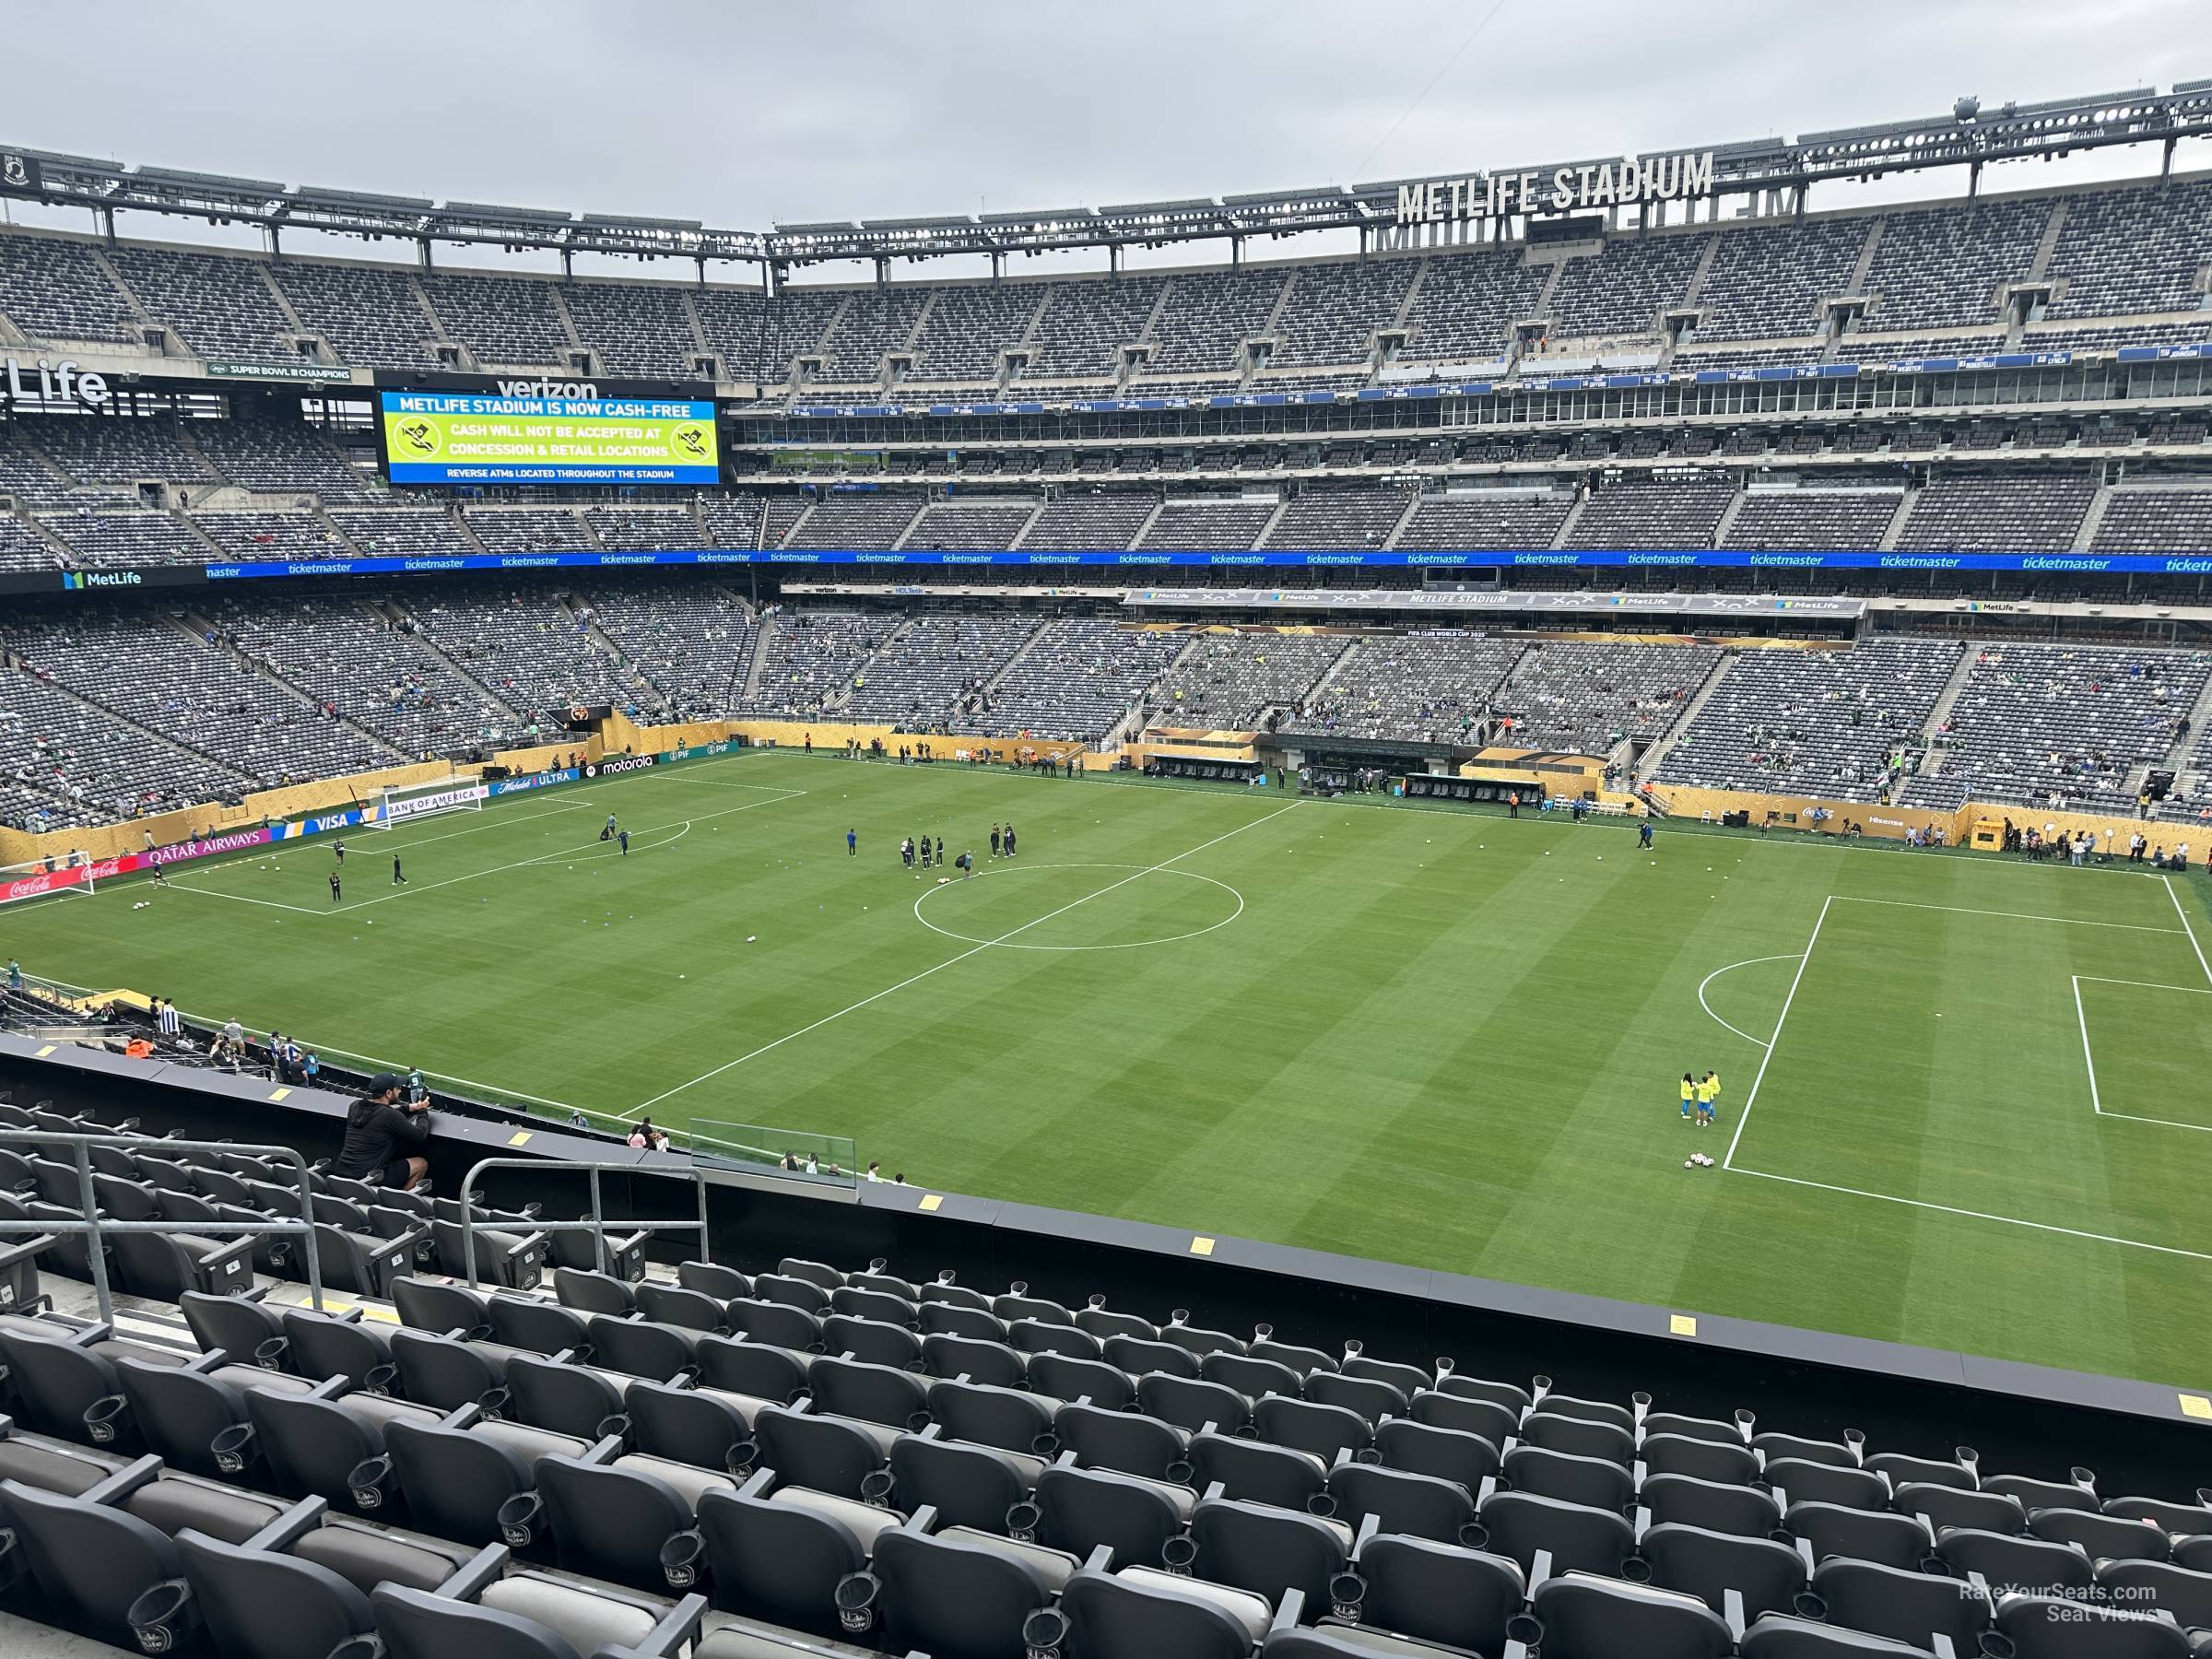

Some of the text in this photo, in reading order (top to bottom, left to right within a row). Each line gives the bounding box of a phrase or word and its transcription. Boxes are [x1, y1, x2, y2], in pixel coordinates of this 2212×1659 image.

[1397, 171, 1539, 224] METLIFE
[1552, 151, 1714, 210] STADIUM
[230, 365, 260, 374] SUPER
[262, 367, 289, 376] BOWL
[300, 369, 350, 379] CHAMPIONS
[0, 358, 108, 403] Life
[497, 377, 598, 400] verizon
[400, 397, 691, 418] METLIFE STADIUM IS NOW CASH-FREE
[451, 424, 662, 440] CASH WILL NOT BE ACCEPTED AT
[449, 443, 668, 457] CONCESSION & RETAIL LOCATIONS
[447, 468, 674, 478] REVERSE ATMs LOCATED THROUGHOUT THE STADIUM
[501, 557, 559, 566] ticketmaster
[601, 554, 656, 563] ticketmaster
[698, 553, 750, 561] ticketmaster
[771, 553, 819, 561] ticketmaster
[856, 553, 906, 562] ticketmaster
[943, 554, 993, 562] ticketmaster
[1030, 554, 1080, 562] ticketmaster
[1120, 554, 1171, 563] ticketmaster
[1211, 554, 1265, 563] ticketmaster
[1307, 554, 1364, 563] ticketmaster
[1407, 553, 1467, 563] ticketmaster
[1514, 553, 1579, 563] ticketmaster
[1628, 553, 1697, 564] ticketmaster
[1750, 554, 1823, 565] ticketmaster
[1881, 555, 1960, 567] ticketmaster
[288, 563, 351, 573] ticketmaster
[406, 559, 465, 570] ticketmaster
[2022, 556, 2111, 570] ticketmaster
[87, 571, 142, 586] MetLife
[1409, 594, 1509, 604] METLIFE STADIUM
[677, 749, 689, 759] PIF
[715, 744, 728, 753] PIF
[603, 756, 653, 775] motorola
[539, 772, 571, 786] ULTRA
[387, 802, 416, 815] BANK
[417, 799, 429, 808] OF
[314, 815, 348, 830] VISA
[1868, 817, 1904, 827] Hisense
[149, 831, 260, 863] QATAR AIRWAYS
[81, 860, 119, 881] Coca-Cola
[10, 877, 51, 898] Coca-Cola
[412, 1077, 418, 1087] 9
